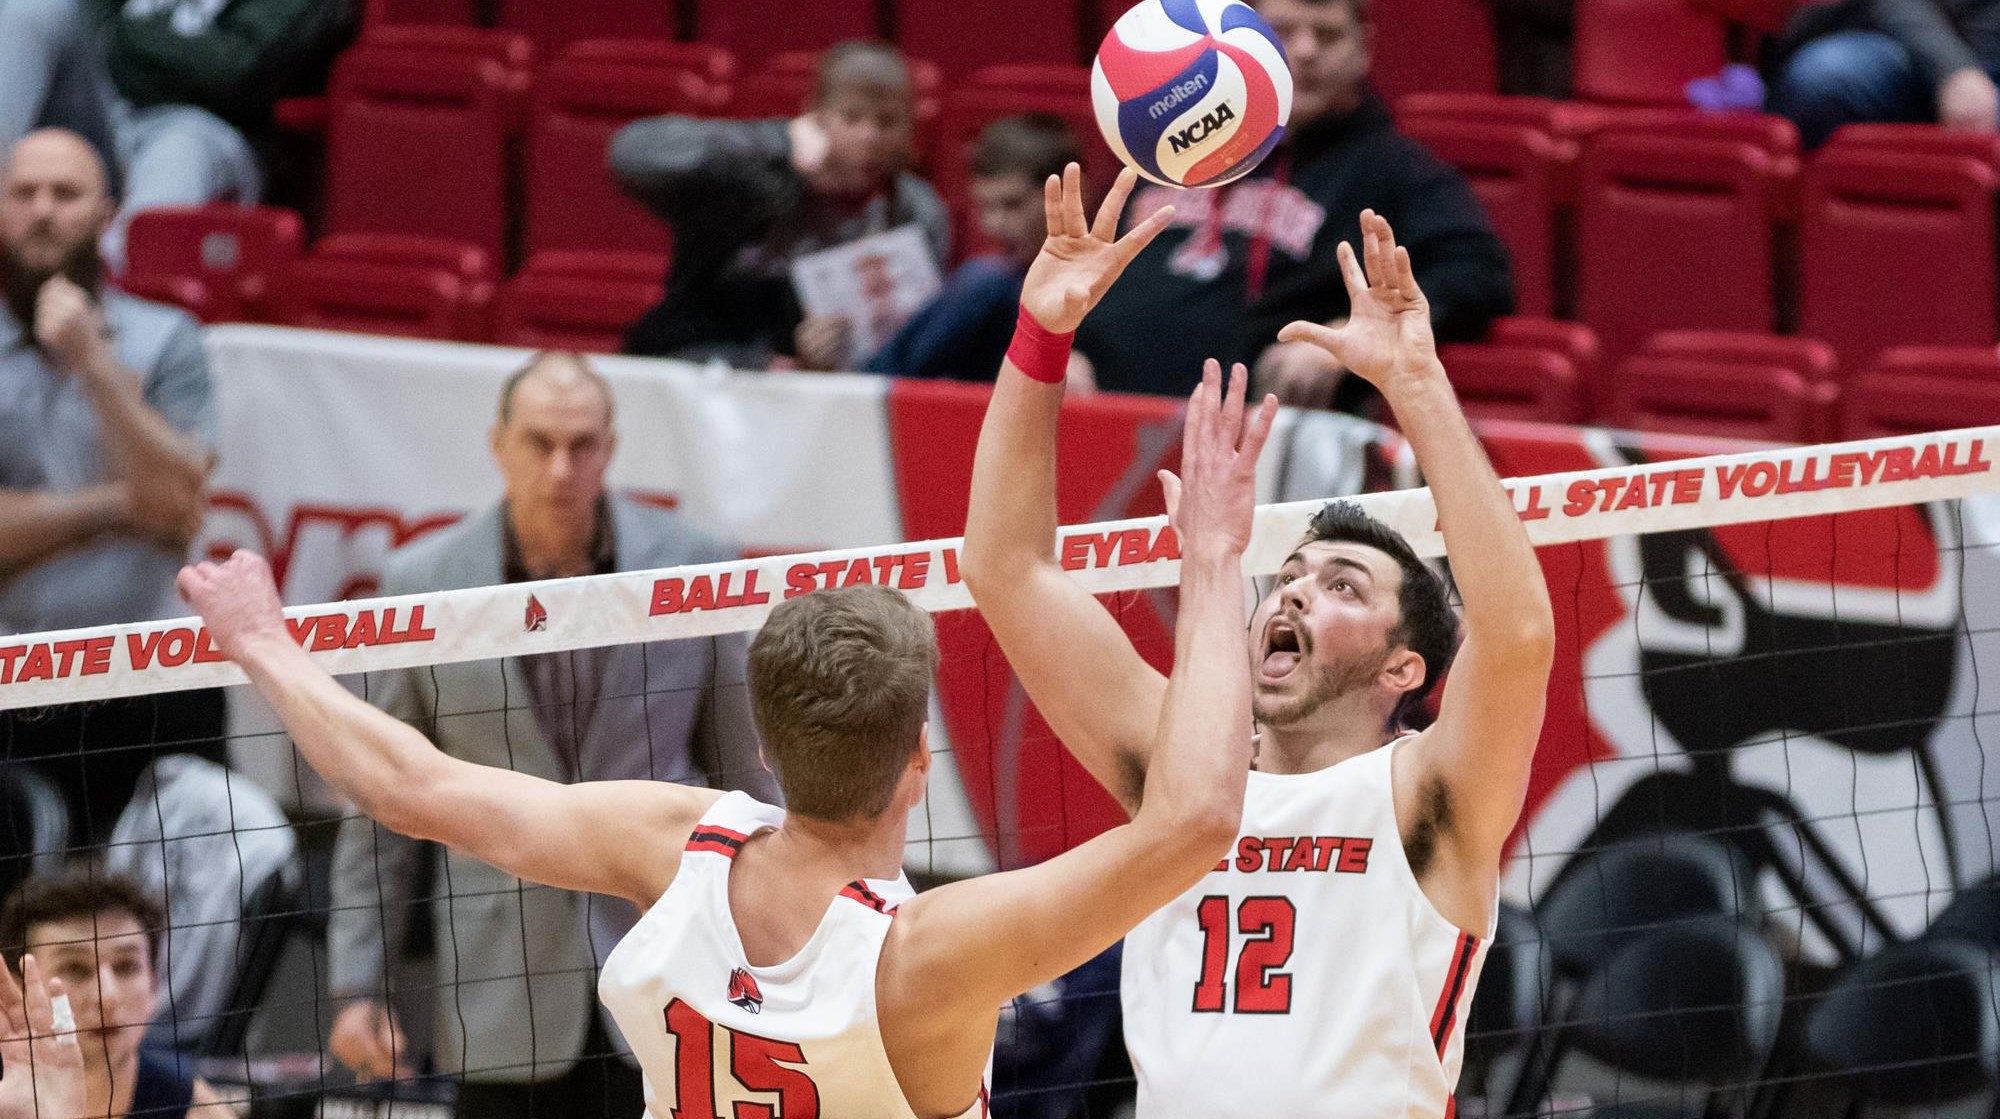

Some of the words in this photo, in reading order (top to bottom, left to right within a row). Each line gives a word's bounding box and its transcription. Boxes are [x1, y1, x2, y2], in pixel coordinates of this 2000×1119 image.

[1149, 73, 1208, 119] molten
[1168, 102, 1235, 153] NCAA
[1563, 469, 1705, 517] STATE
[1716, 439, 1991, 500] VOLLEYBALL
[649, 569, 769, 617] BALL
[784, 552, 930, 598] STATE
[127, 605, 436, 671] VOLYBALL
[1236, 836, 1373, 874] STATE
[1192, 895, 1296, 1014] 12
[663, 997, 820, 1119] 15
